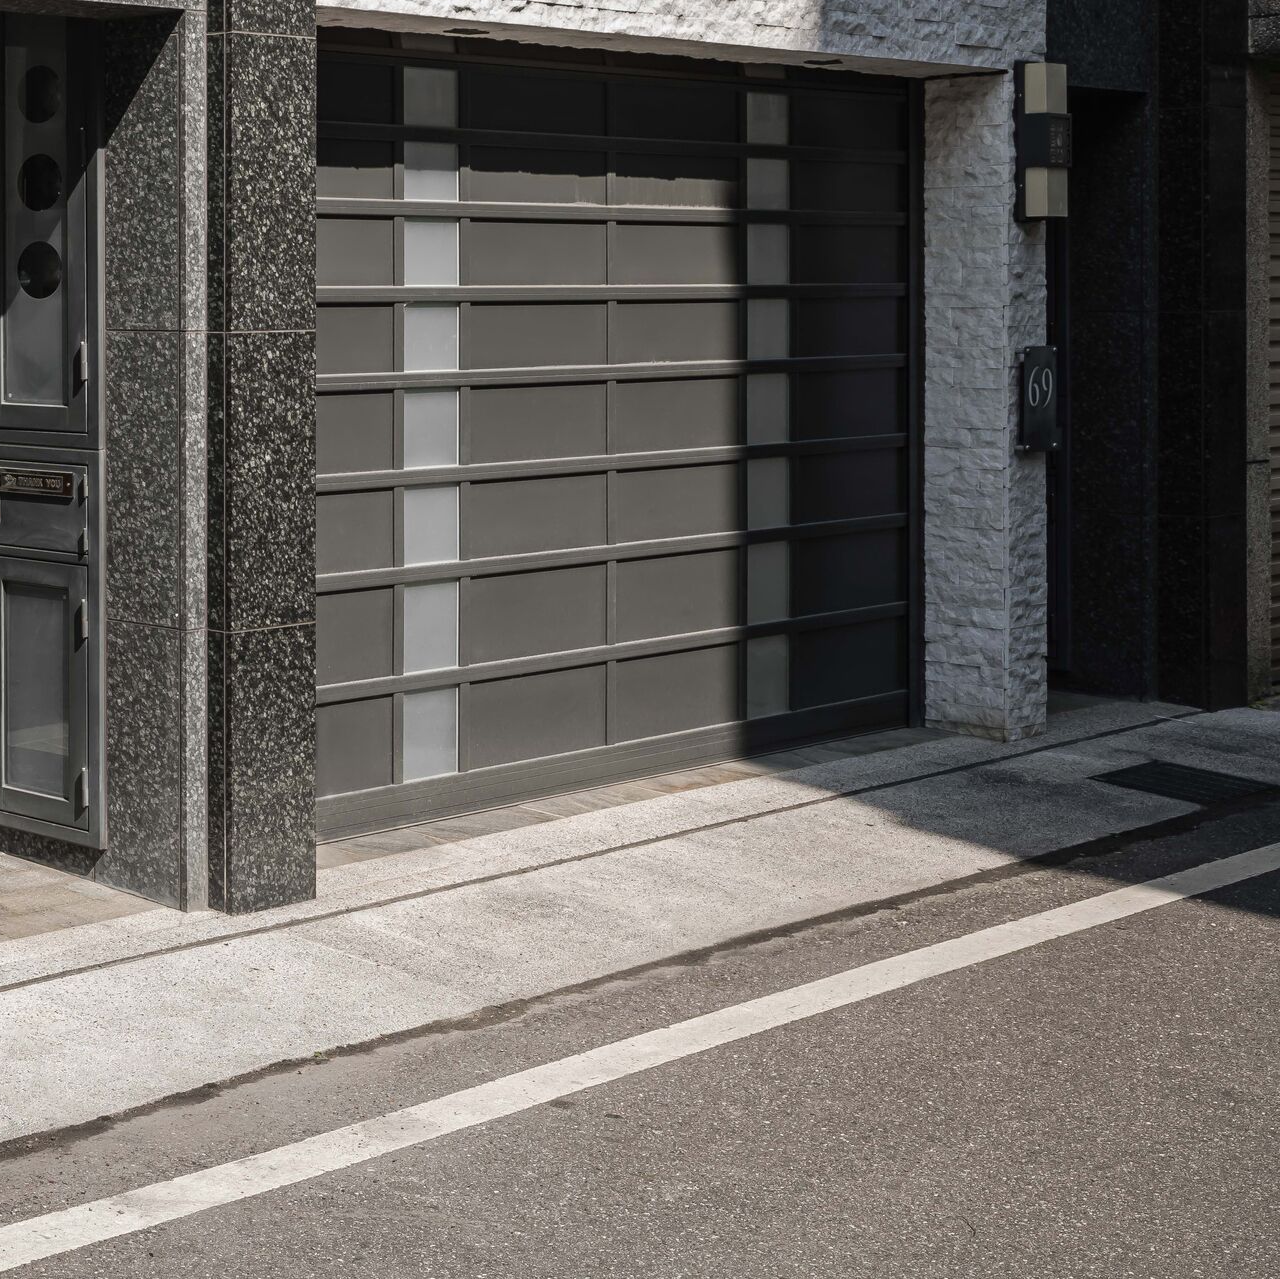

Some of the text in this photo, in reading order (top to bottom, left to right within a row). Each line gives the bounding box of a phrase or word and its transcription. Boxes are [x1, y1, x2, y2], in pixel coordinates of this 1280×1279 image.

[1028, 365, 1053, 409] 69
[17, 476, 62, 489] THANK YOU
